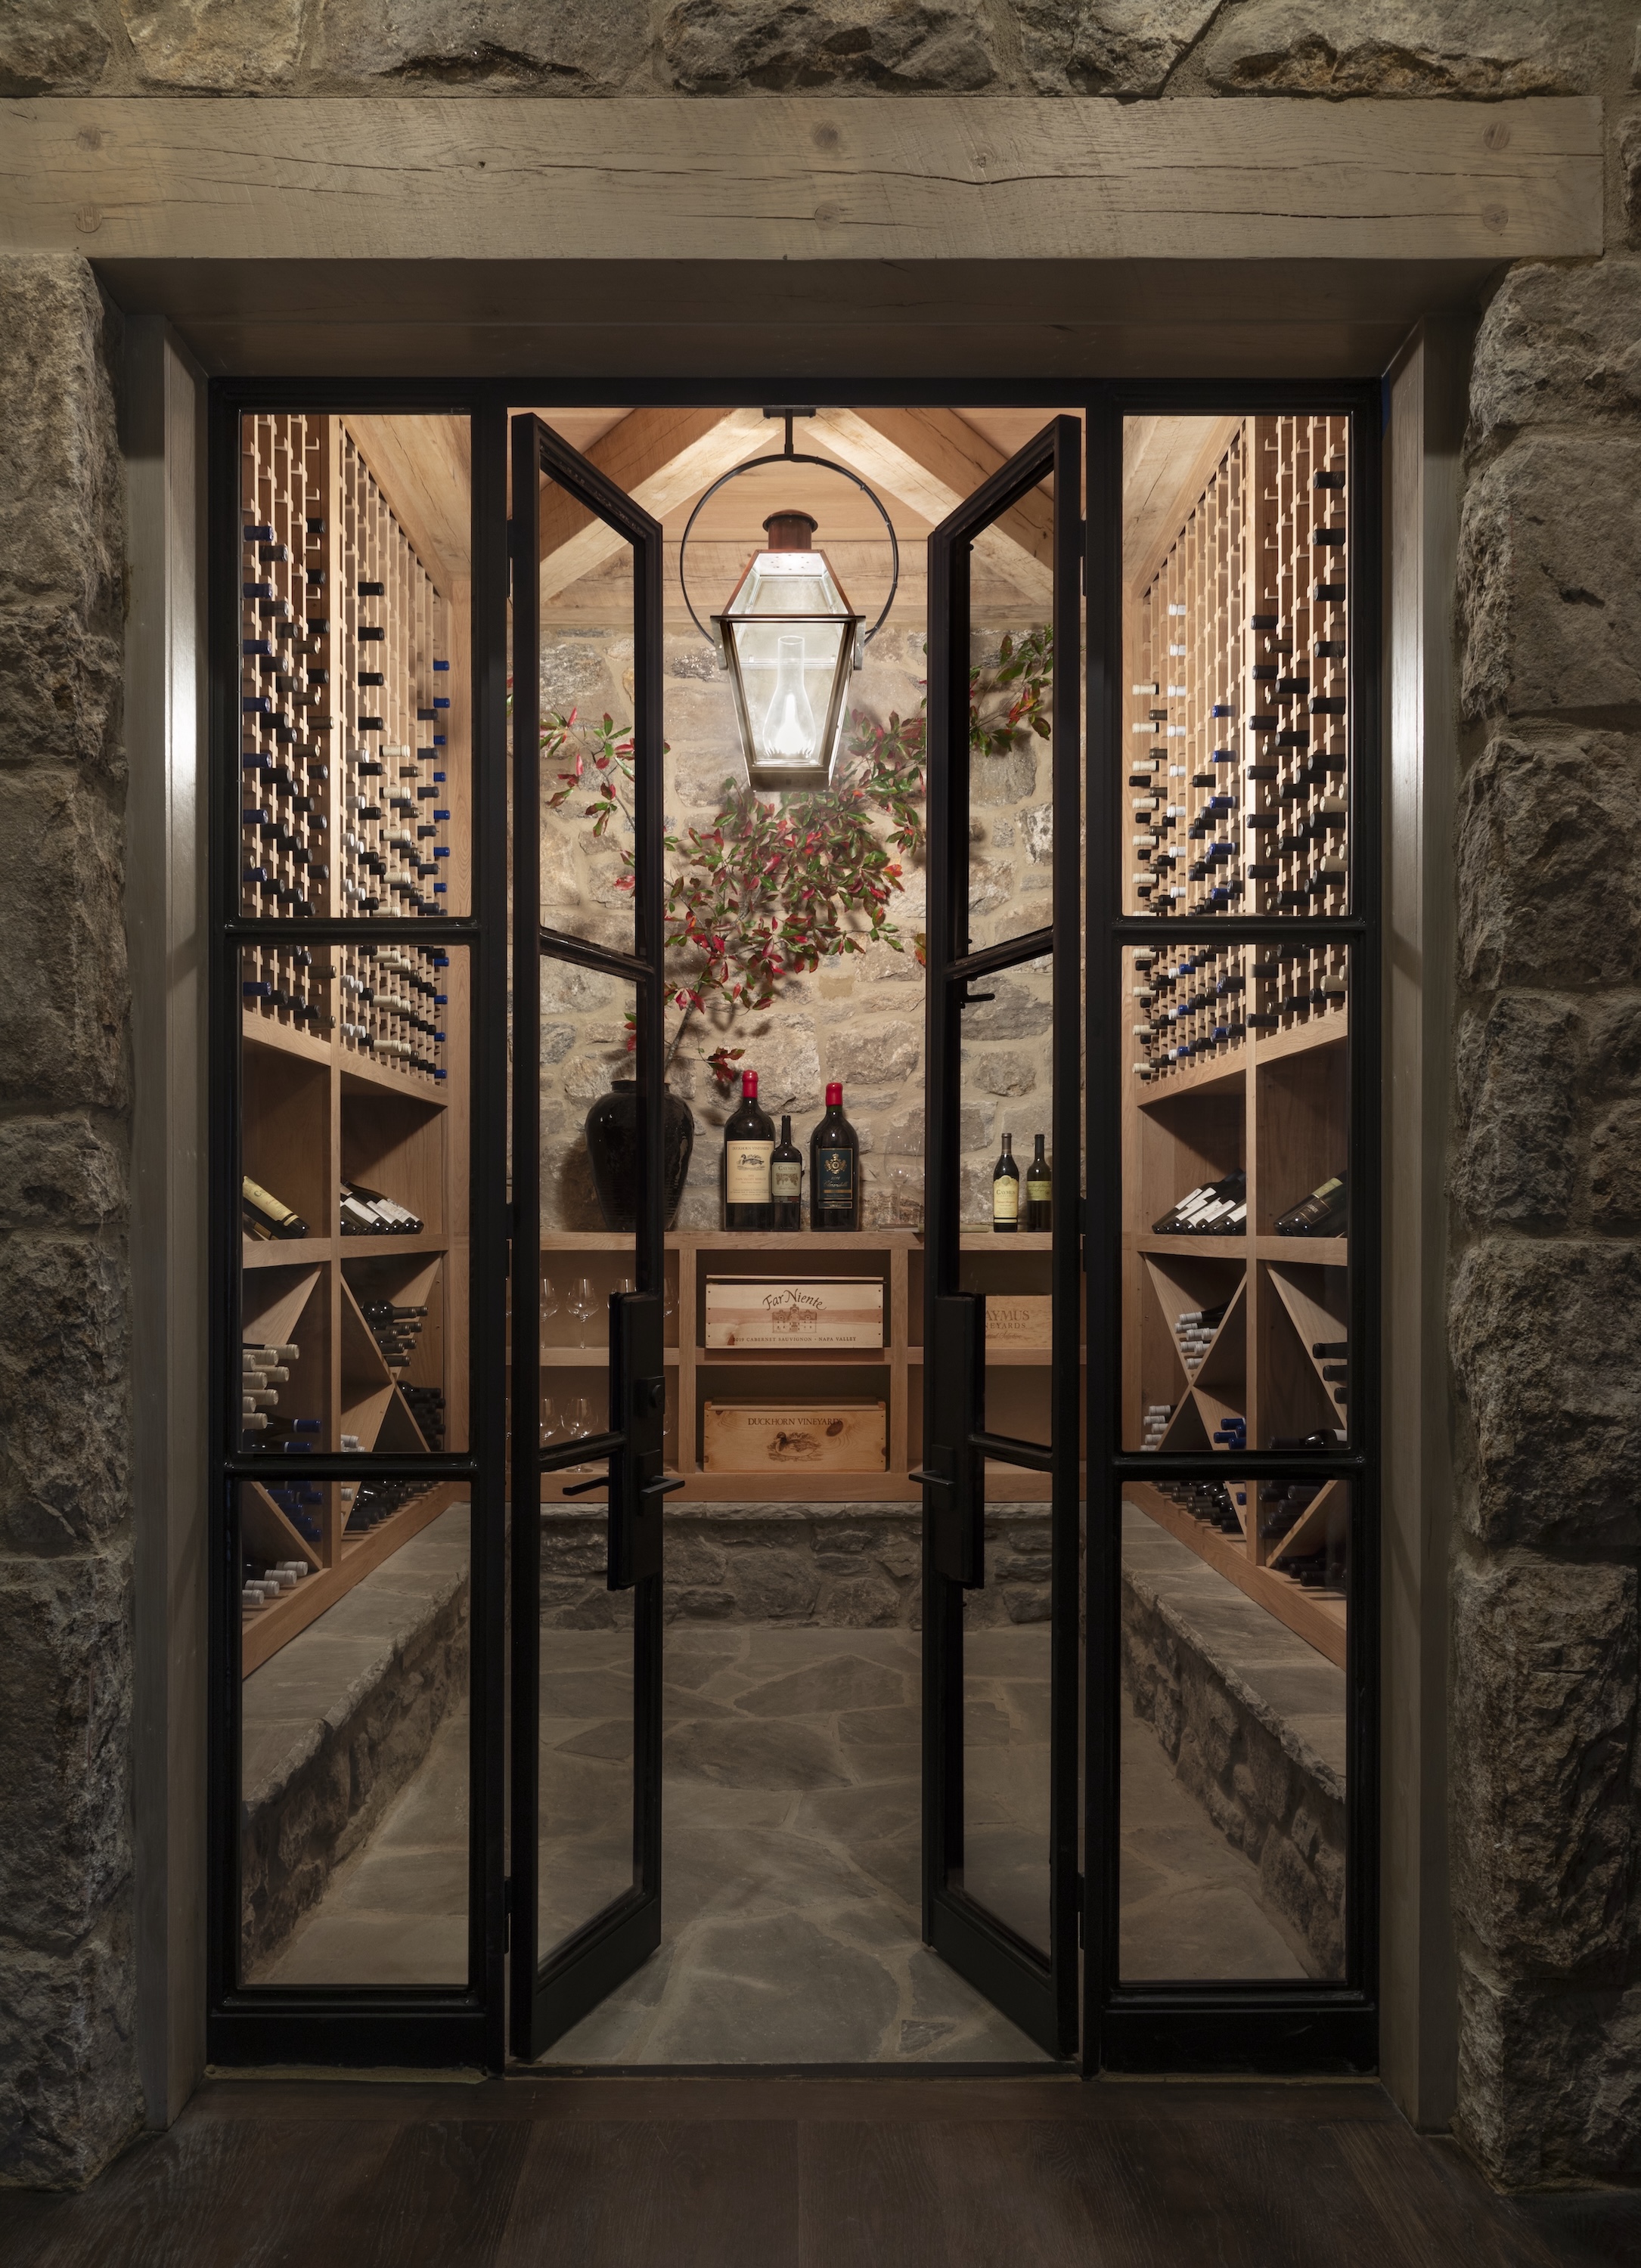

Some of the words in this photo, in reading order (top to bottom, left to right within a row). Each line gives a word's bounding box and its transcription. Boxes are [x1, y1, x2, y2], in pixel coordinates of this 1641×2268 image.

[762, 1294, 784, 1311] Far
[783, 1288, 827, 1311] Niente
[985, 1310, 1030, 1321] AYMUS
[748, 1418, 795, 1426] DUCKHORN
[797, 1418, 843, 1426] VINEYARDS
